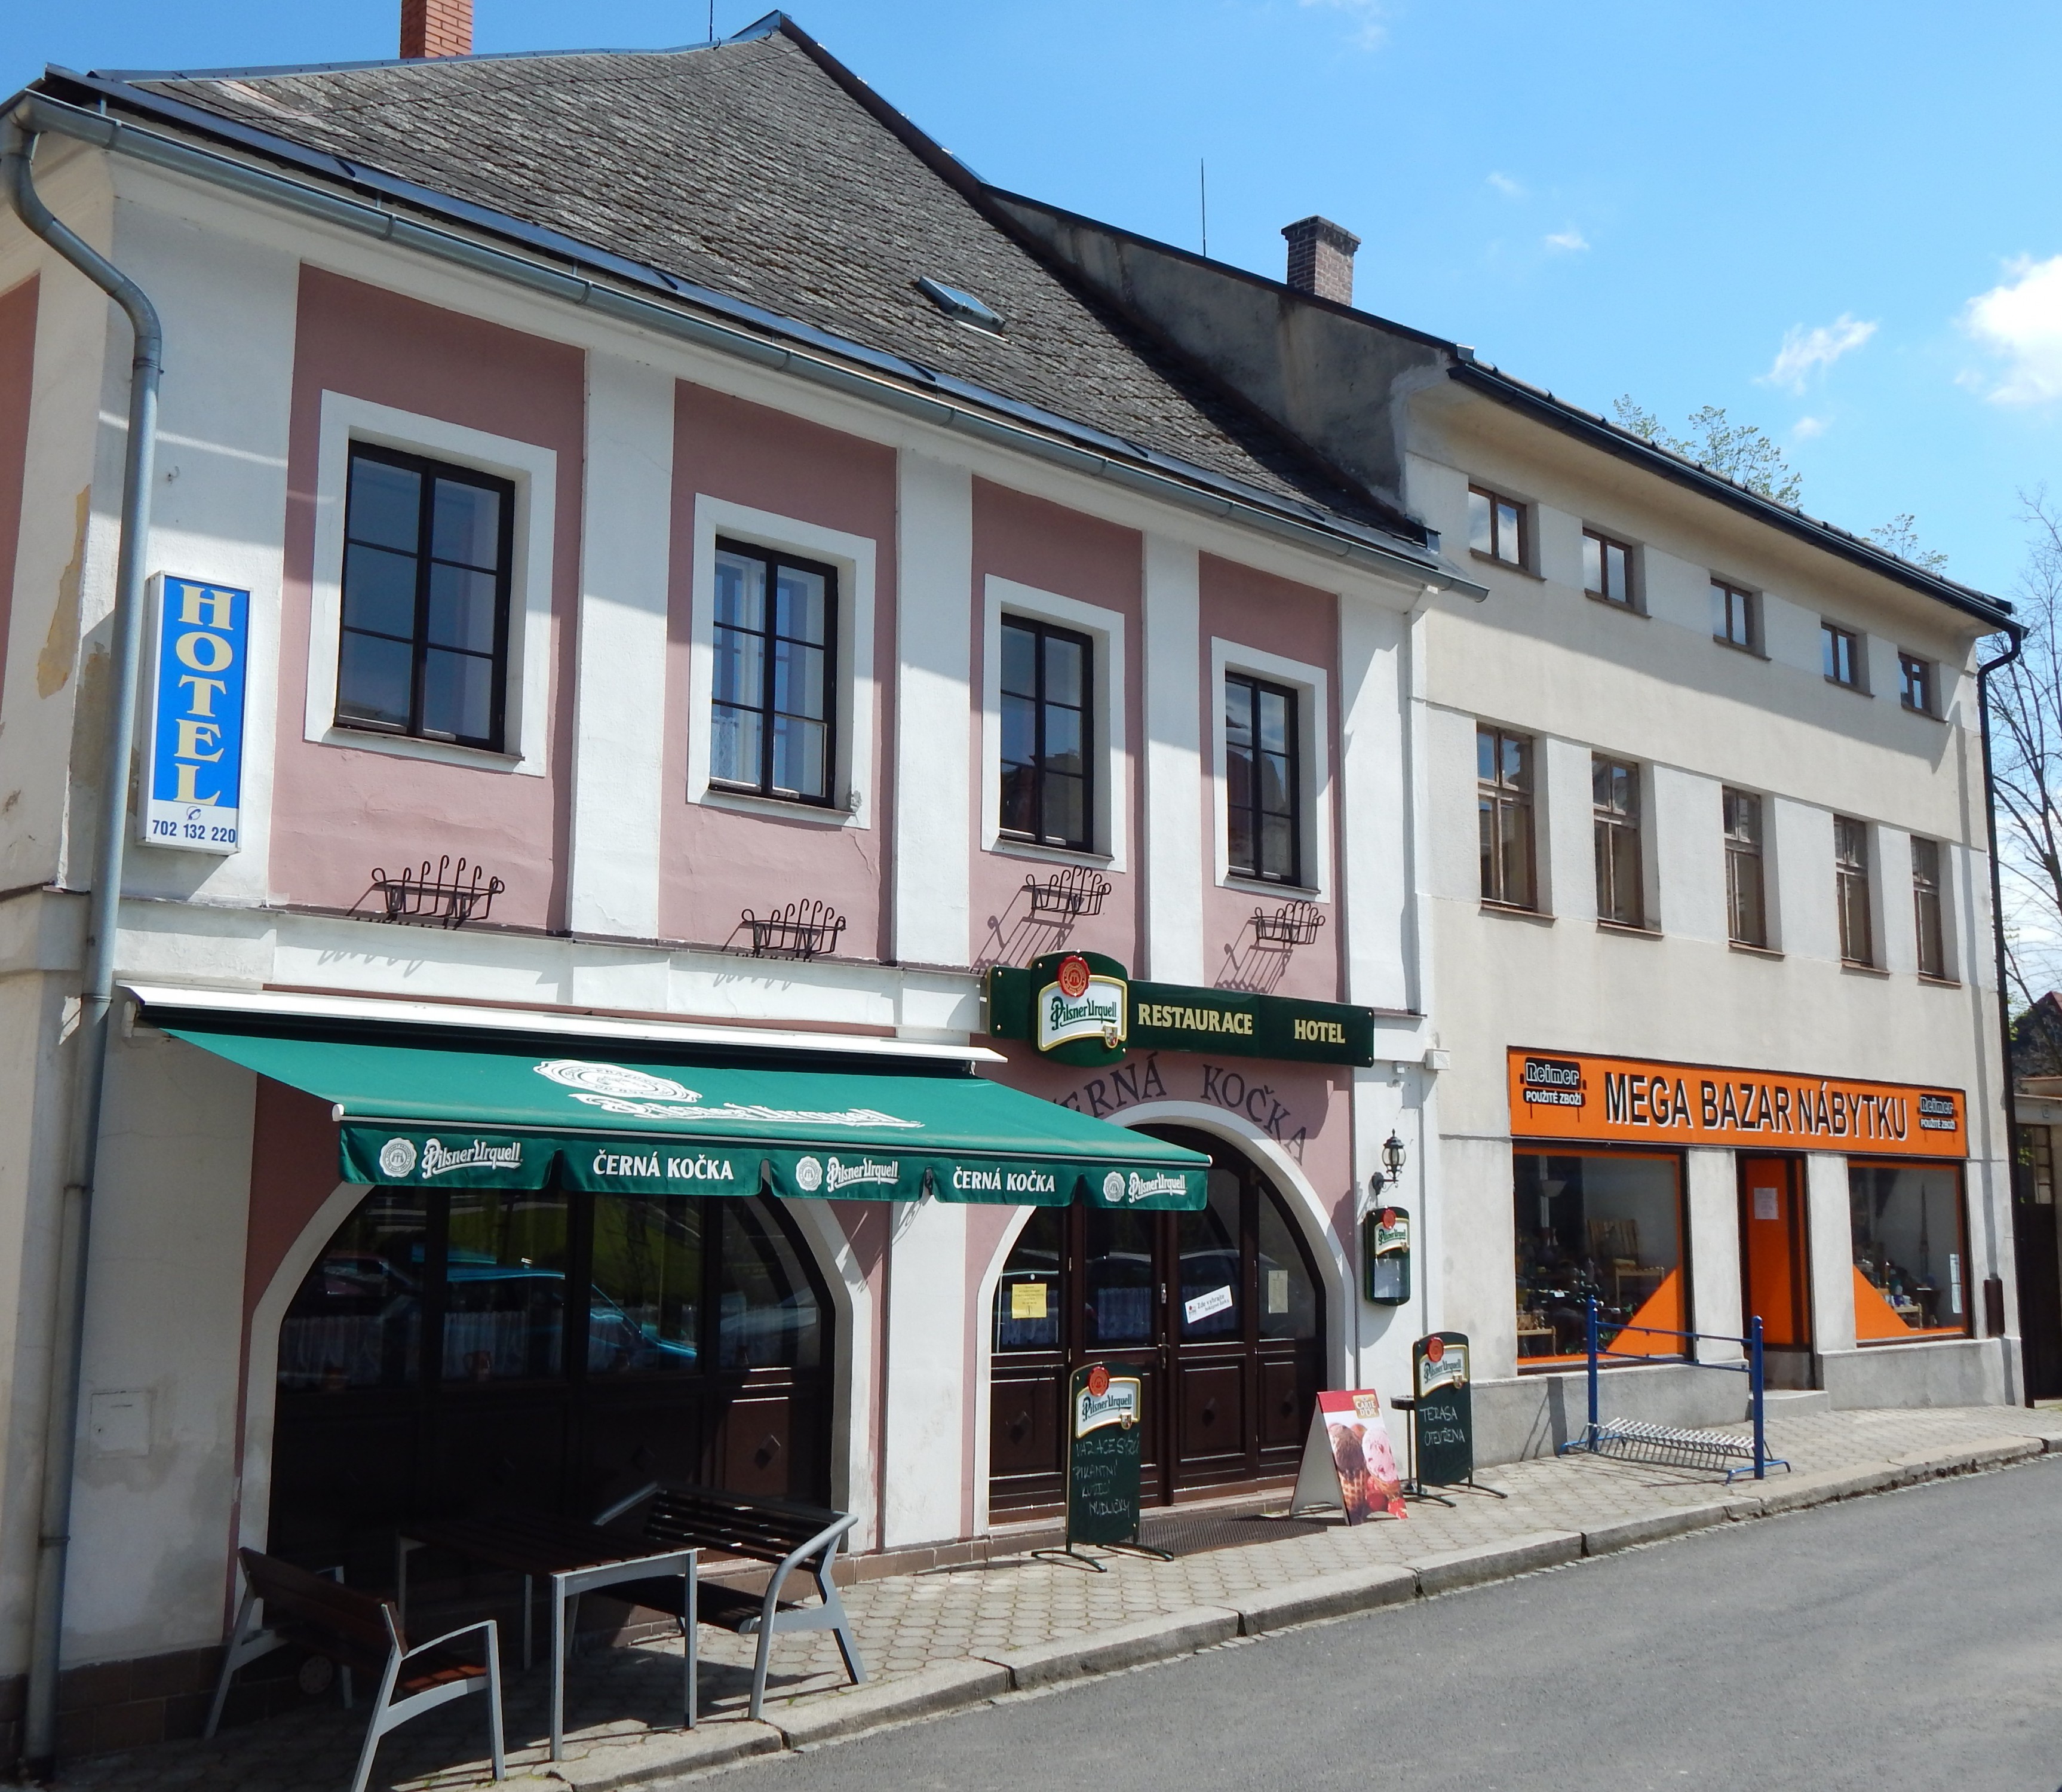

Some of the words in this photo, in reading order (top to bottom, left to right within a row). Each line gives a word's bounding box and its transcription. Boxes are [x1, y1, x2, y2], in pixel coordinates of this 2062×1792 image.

[173, 584, 235, 806] HOTEL
[152, 820, 177, 836] 702
[183, 824, 205, 840] 132
[211, 827, 236, 843] 220
[1050, 996, 1088, 1031] Pilsner
[1087, 998, 1117, 1024] Urquell
[1138, 1004, 1253, 1035] RESTAURACE
[1294, 1019, 1346, 1044] HOTEL
[1525, 1062, 1579, 1085] Reimer
[1525, 1090, 1558, 1104] POUŽITÉ
[1559, 1093, 1582, 1105] ZBOŽÍ
[1605, 1072, 1693, 1129] MEGA
[1701, 1080, 1794, 1135] BAZAR
[1797, 1081, 1908, 1142] NÁBYTKU
[1920, 1096, 1954, 1115] Reimer
[1200, 1063, 1308, 1166] KOČKA
[422, 1138, 475, 1179] Pilsner
[473, 1139, 521, 1170] Urquell
[593, 1149, 661, 1177] ČERNÁ
[667, 1154, 734, 1180] KOČKA
[826, 1156, 864, 1192] Pilsner
[863, 1157, 898, 1185] Urquell
[953, 1166, 1002, 1190] ČERNÁ
[1007, 1170, 1055, 1192] KOČKA
[1128, 1171, 1158, 1204] Pilsner
[1156, 1171, 1185, 1196] Urquell
[1082, 1396, 1108, 1422] Pilsner
[1107, 1394, 1132, 1411] Urquell
[1356, 1400, 1376, 1409] CARTE
[1419, 1406, 1458, 1423] TERASA
